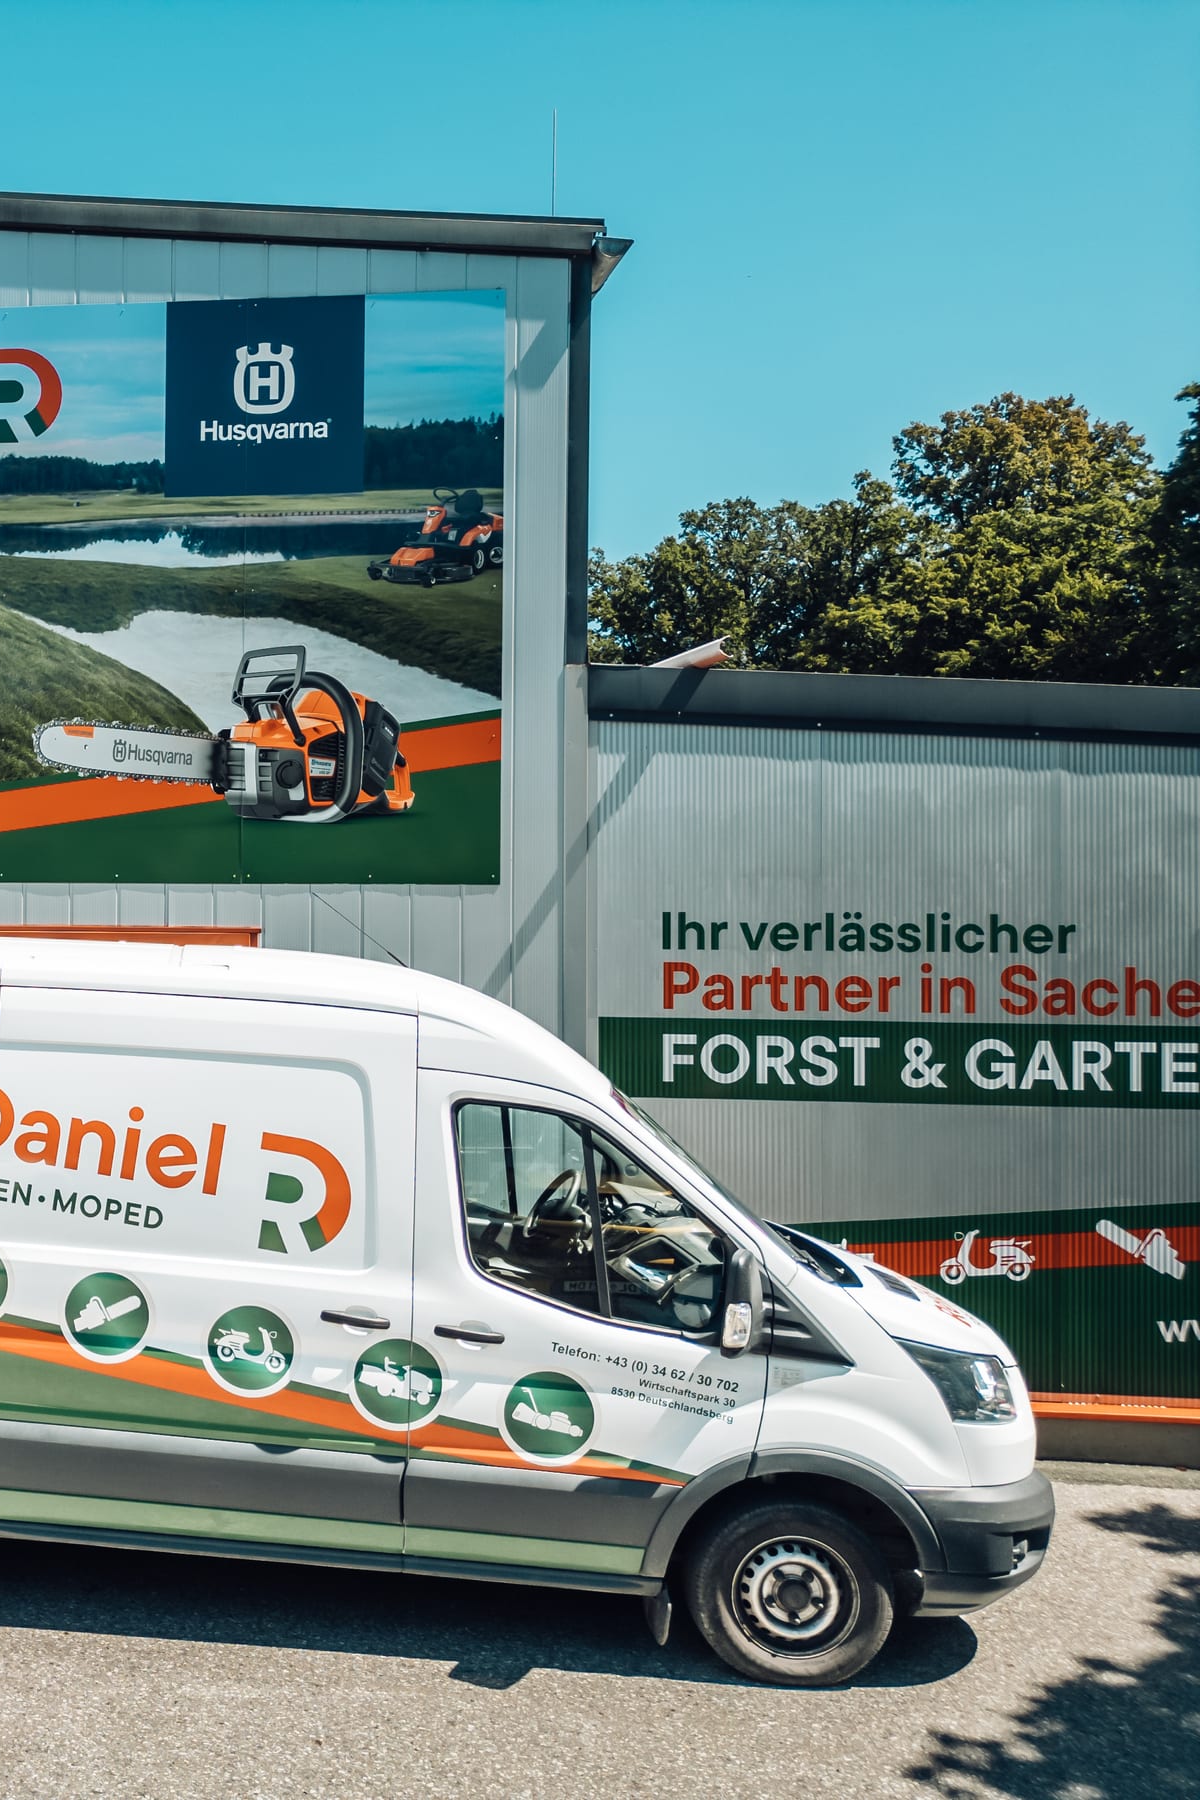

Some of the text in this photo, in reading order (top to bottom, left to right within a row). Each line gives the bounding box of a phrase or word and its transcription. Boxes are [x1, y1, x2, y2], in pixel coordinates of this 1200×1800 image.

[200, 419, 328, 444] Husqvarna
[128, 744, 192, 765] Husqvarna
[661, 912, 1076, 954] Ihr verlässlicher
[662, 962, 1200, 1017] Partner in Sache
[661, 1033, 1200, 1093] FORST & GARTE
[551, 1342, 739, 1393] Telefon: +43 (0) 34 62 / 30 702
[611, 1387, 734, 1425] 8530 Deutschlandsberg
[638, 1378, 736, 1408] Wirtschaftspark 30
